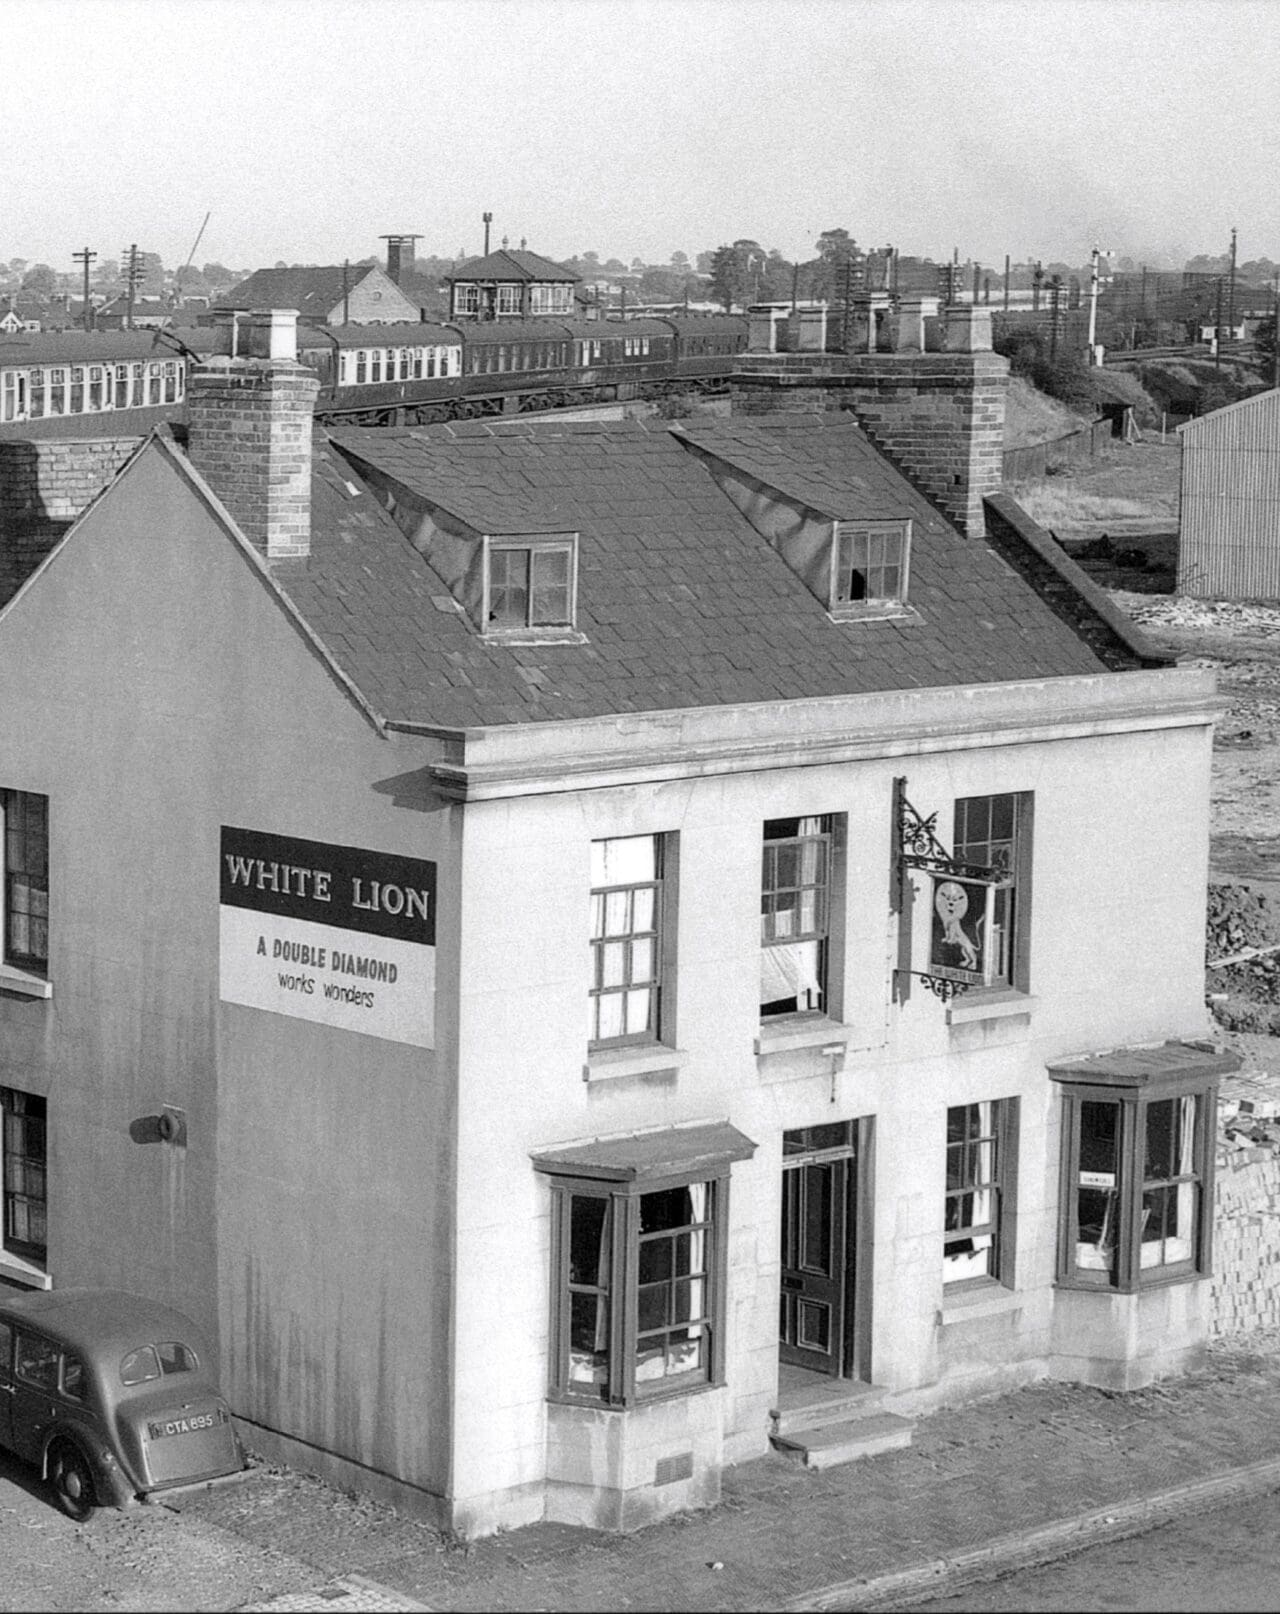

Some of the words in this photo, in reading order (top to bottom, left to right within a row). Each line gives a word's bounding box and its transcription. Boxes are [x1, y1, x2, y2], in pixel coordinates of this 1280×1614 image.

[224, 853, 332, 902] WHITE
[352, 877, 430, 921] LION
[256, 935, 267, 957] A
[272, 938, 327, 968] DOUBLE
[331, 951, 398, 984] DIAMOND
[277, 972, 316, 995] works
[323, 982, 375, 1009] wonders
[165, 1420, 190, 1434] CTA
